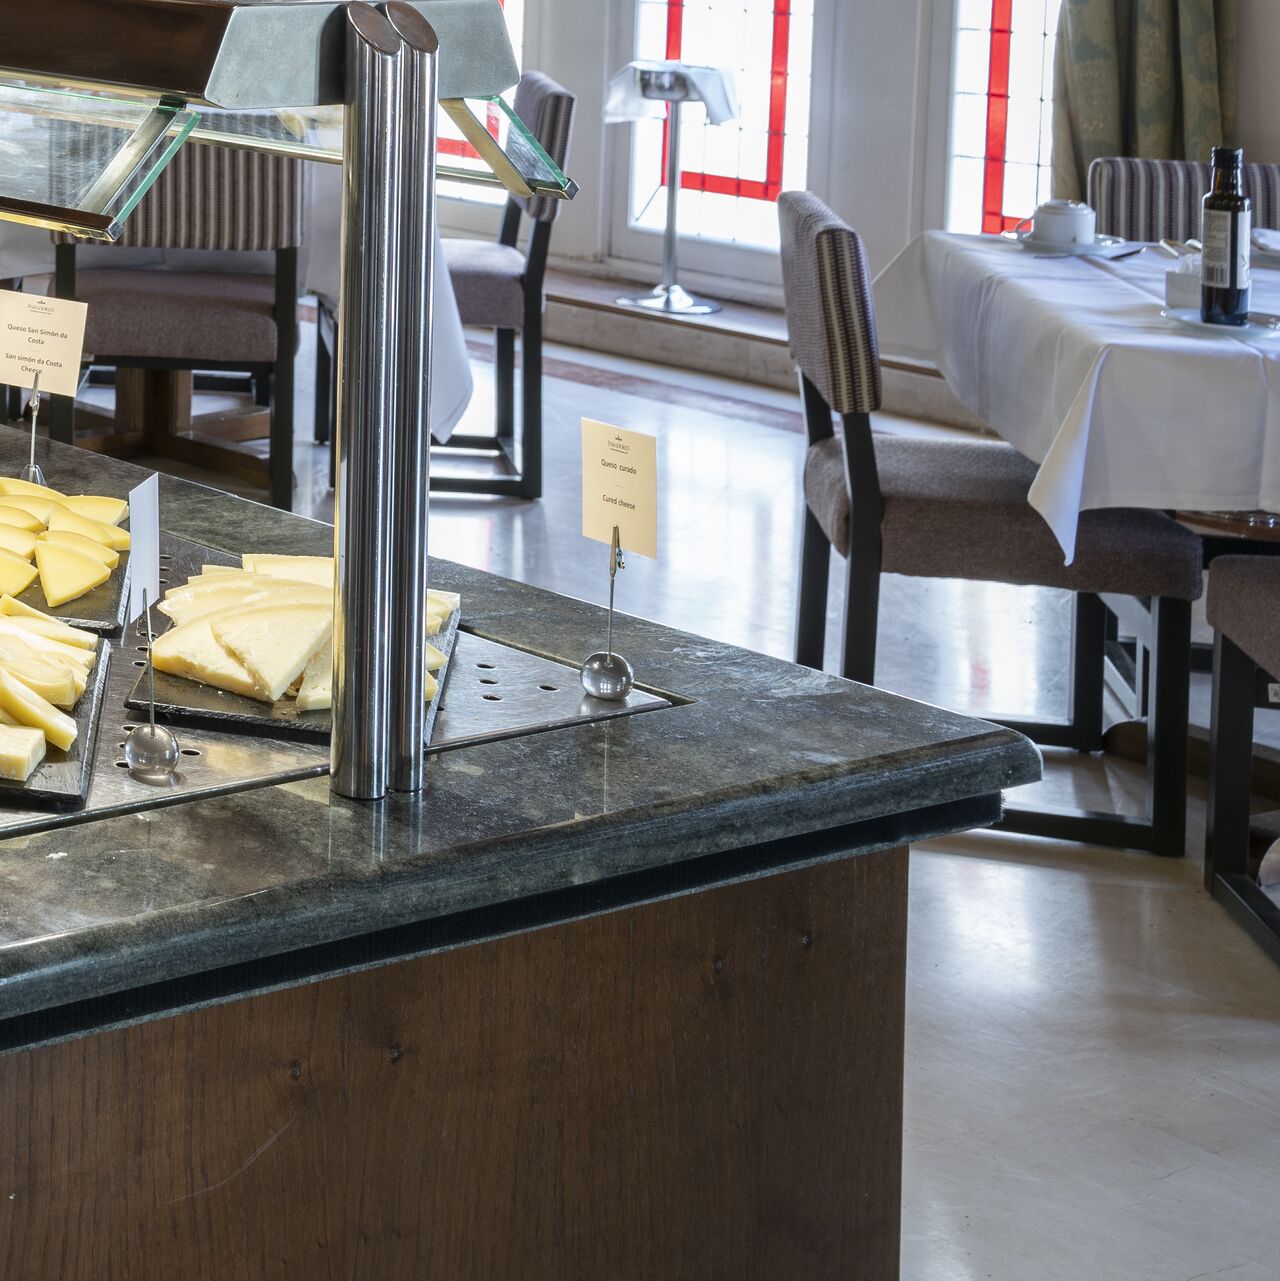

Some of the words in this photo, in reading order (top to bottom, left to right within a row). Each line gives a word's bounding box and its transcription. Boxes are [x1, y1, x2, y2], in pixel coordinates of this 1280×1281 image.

[7, 323, 27, 332] Queso
[40, 329, 59, 337] Simón
[27, 337, 45, 345] Costa
[5, 352, 17, 360] San
[17, 354, 36, 363] simón
[45, 359, 63, 368] Costa
[21, 365, 43, 374] Cheese
[600, 459, 617, 469] Queso
[619, 464, 637, 475] curado
[602, 494, 618, 505] Cured
[618, 499, 636, 511] cheese
